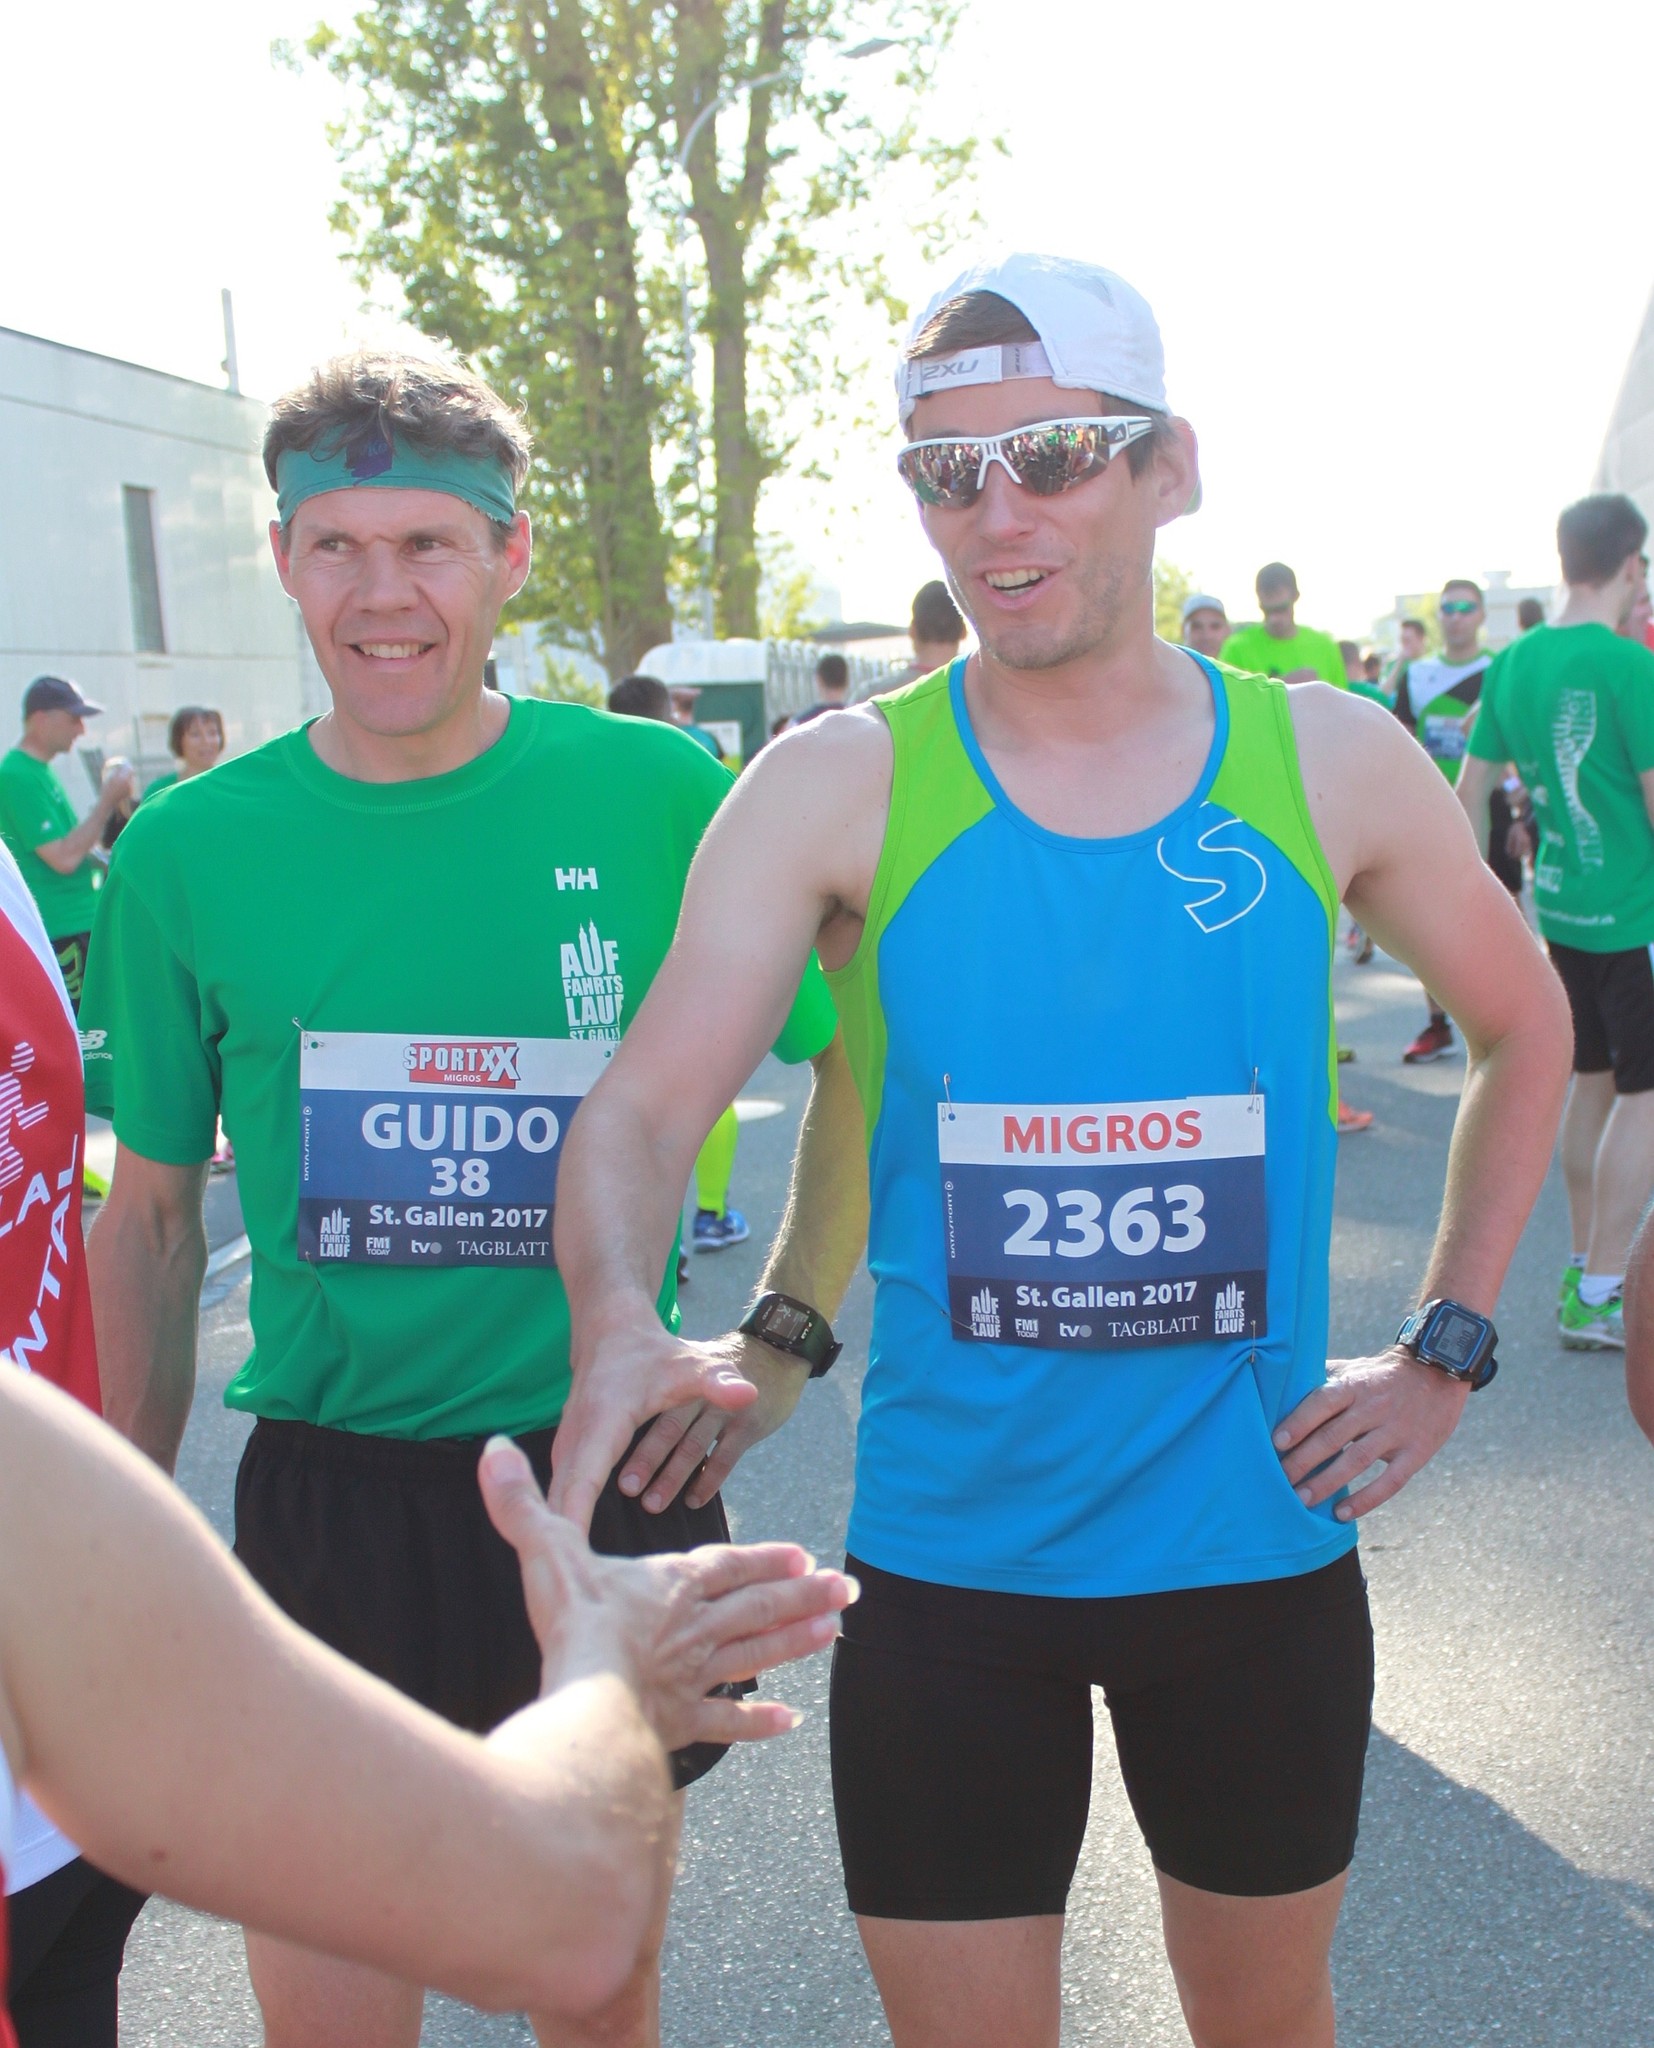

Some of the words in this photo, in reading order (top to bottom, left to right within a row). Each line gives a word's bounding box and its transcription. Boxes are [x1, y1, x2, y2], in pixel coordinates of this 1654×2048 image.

[922, 359, 979, 380] 2XU
[555, 868, 598, 890] HH
[560, 917, 620, 978] AUF
[562, 975, 624, 997] FAHRTS
[443, 1074, 482, 1083] MIGROS
[361, 1103, 560, 1154] GUIDO
[1003, 1110, 1203, 1154] MIGROS
[430, 1158, 491, 1197] 38
[320, 1207, 351, 1234] AUF
[369, 1204, 401, 1225] St.
[405, 1205, 484, 1227] Gallen
[490, 1208, 548, 1228] 2017
[1002, 1184, 1206, 1258] 2363
[320, 1234, 350, 1244] FAHRTS
[366, 1236, 391, 1249] FM1
[457, 1240, 549, 1256] TAGBLATT
[320, 1243, 351, 1257] LAUF
[366, 1248, 391, 1256] TODAY
[971, 1286, 999, 1314] AUF
[1016, 1285, 1048, 1307] St.
[1052, 1285, 1136, 1309] Gallen
[1142, 1280, 1198, 1306] 2017
[1215, 1280, 1246, 1310] AUF
[971, 1313, 1000, 1324] FAHRTS
[1015, 1318, 1039, 1331] FM1
[1215, 1308, 1245, 1320] FAHRTS
[973, 1322, 1001, 1338] LAUF
[1016, 1330, 1039, 1339] TODAY
[1108, 1315, 1200, 1338] TAGBLATT
[1215, 1318, 1245, 1335] LAUF
